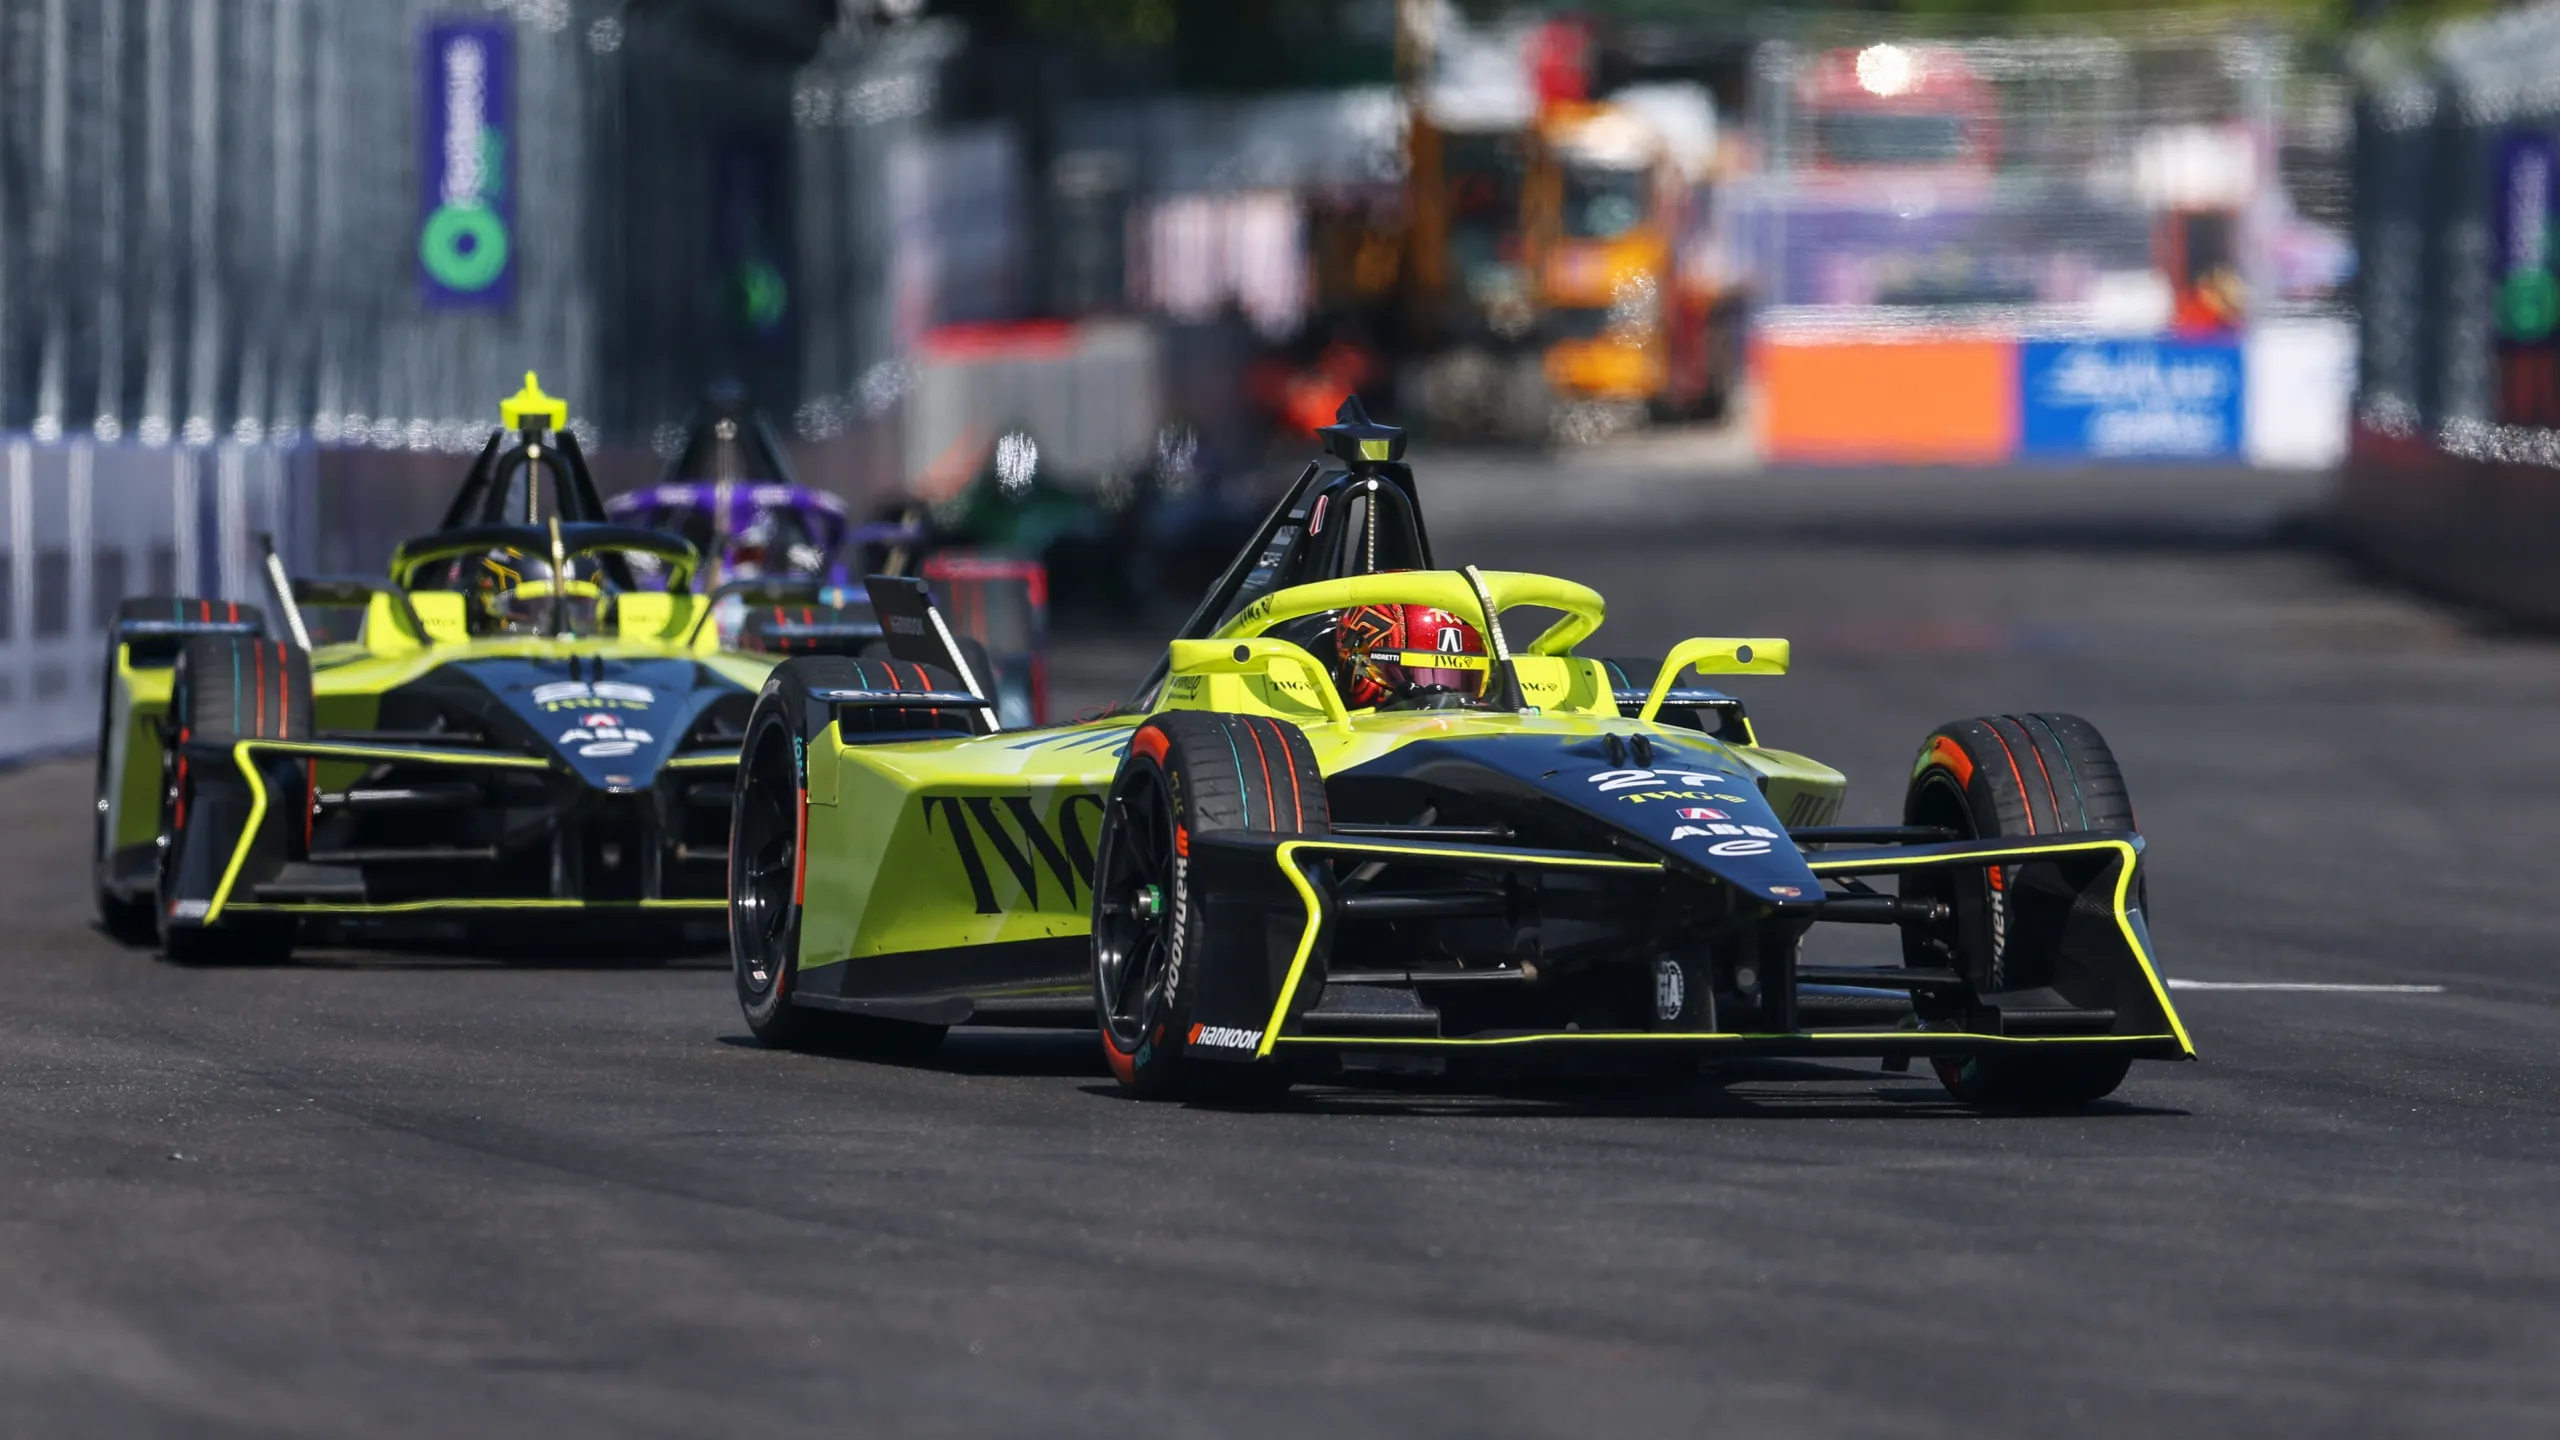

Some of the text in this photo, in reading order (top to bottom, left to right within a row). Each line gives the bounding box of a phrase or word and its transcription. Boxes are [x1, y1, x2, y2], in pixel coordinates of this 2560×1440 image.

[1370, 653, 1463, 668] ANDRETTI TWG
[1271, 681, 1303, 691] TWG
[1520, 683, 1546, 692] WG
[1588, 769, 1724, 792] 27
[1619, 791, 1712, 804] TWG
[1671, 823, 1778, 841] ABB
